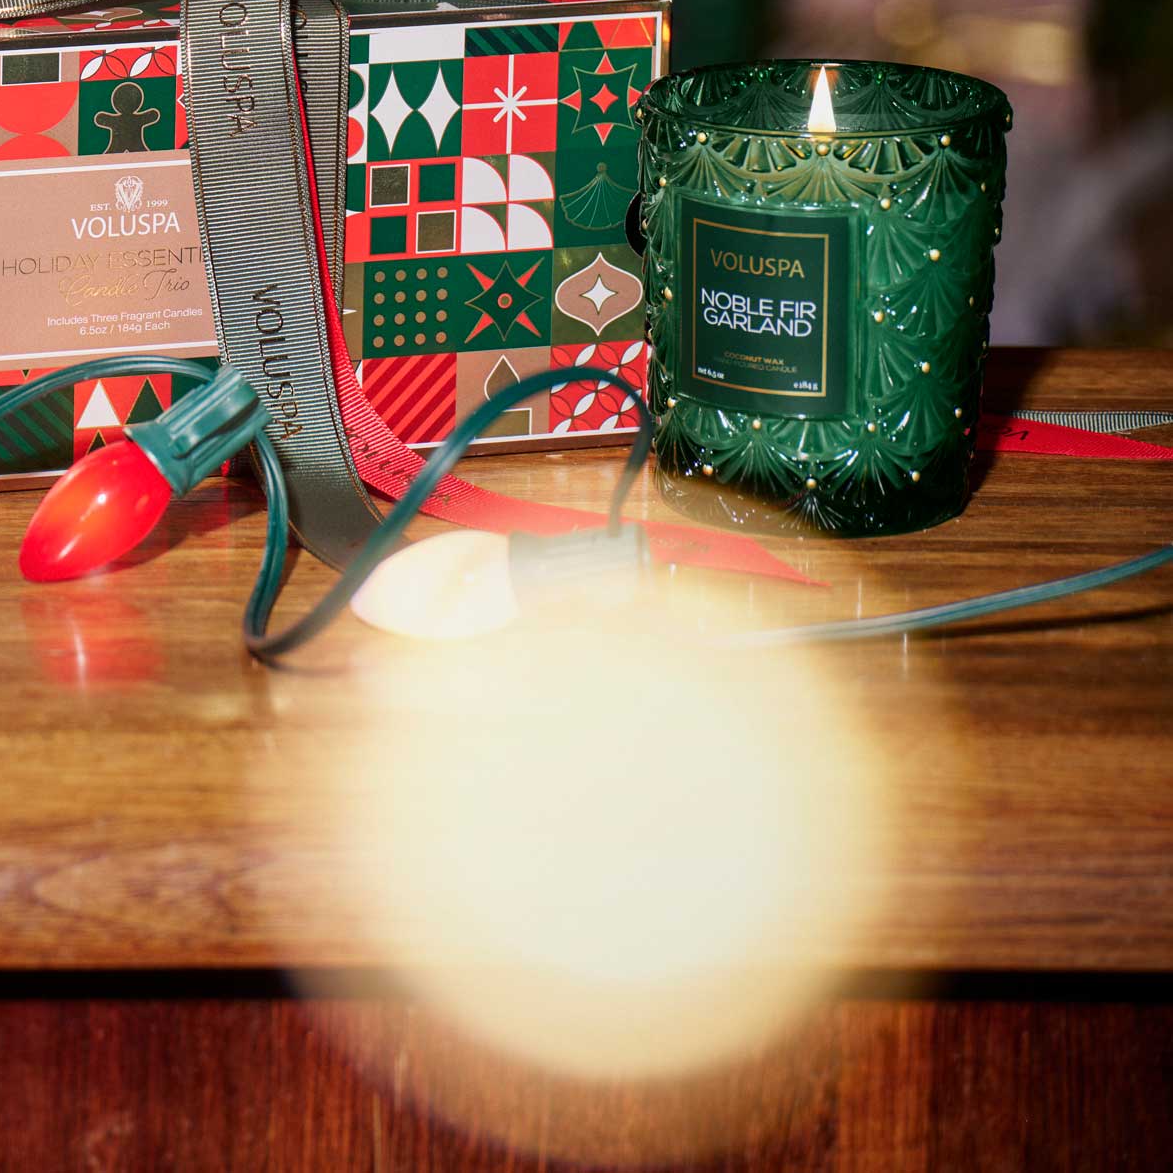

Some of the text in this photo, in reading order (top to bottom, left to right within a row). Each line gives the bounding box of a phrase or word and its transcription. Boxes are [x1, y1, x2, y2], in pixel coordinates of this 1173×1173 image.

[89, 199, 169, 212] EST. 1999
[71, 211, 181, 239] VOLUSPA
[2, 246, 206, 276] HOLIDAY ESSENTI
[710, 248, 805, 279] VOLUSPA
[59, 268, 190, 306] Candle Trio
[47, 307, 203, 327] Includes Three Fragrant Candles
[701, 287, 816, 320] NOBLE FIR
[79, 325, 108, 336] 6.5oz
[117, 323, 142, 334] 184g
[144, 320, 170, 331] Each
[703, 307, 812, 338] GARLAND
[251, 284, 304, 441] VOLUSPA
